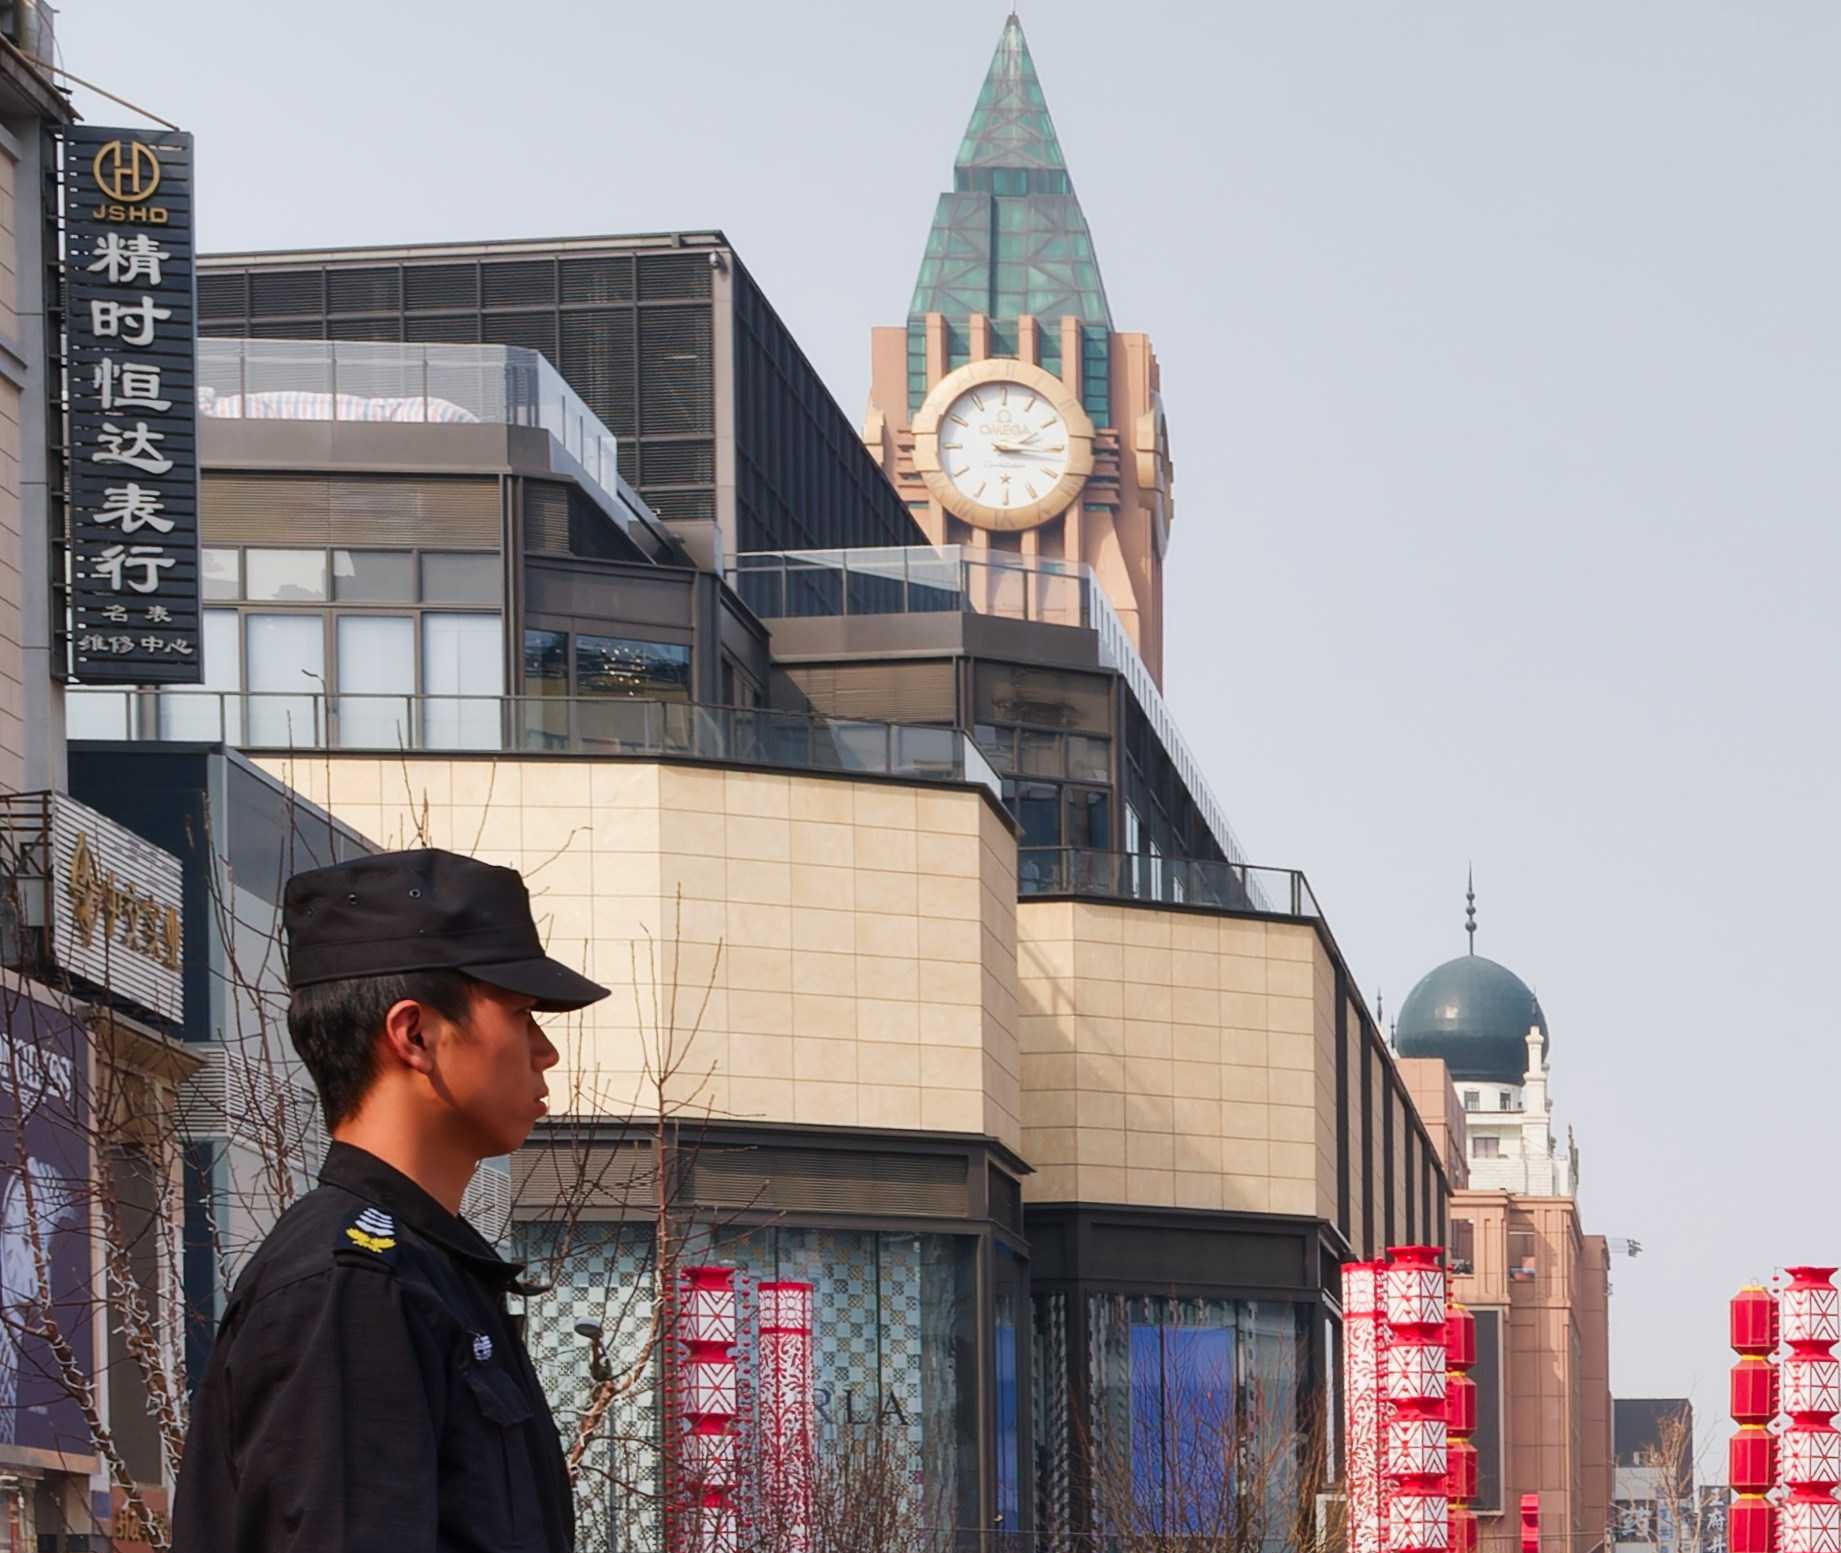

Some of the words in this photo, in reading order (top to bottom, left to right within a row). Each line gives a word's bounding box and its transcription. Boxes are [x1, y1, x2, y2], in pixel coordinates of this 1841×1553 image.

[92, 203, 168, 224] JSHD
[86, 232, 177, 594] 精时恒达表行
[78, 634, 194, 655] 维修中心
[812, 1388, 911, 1426] RLA
